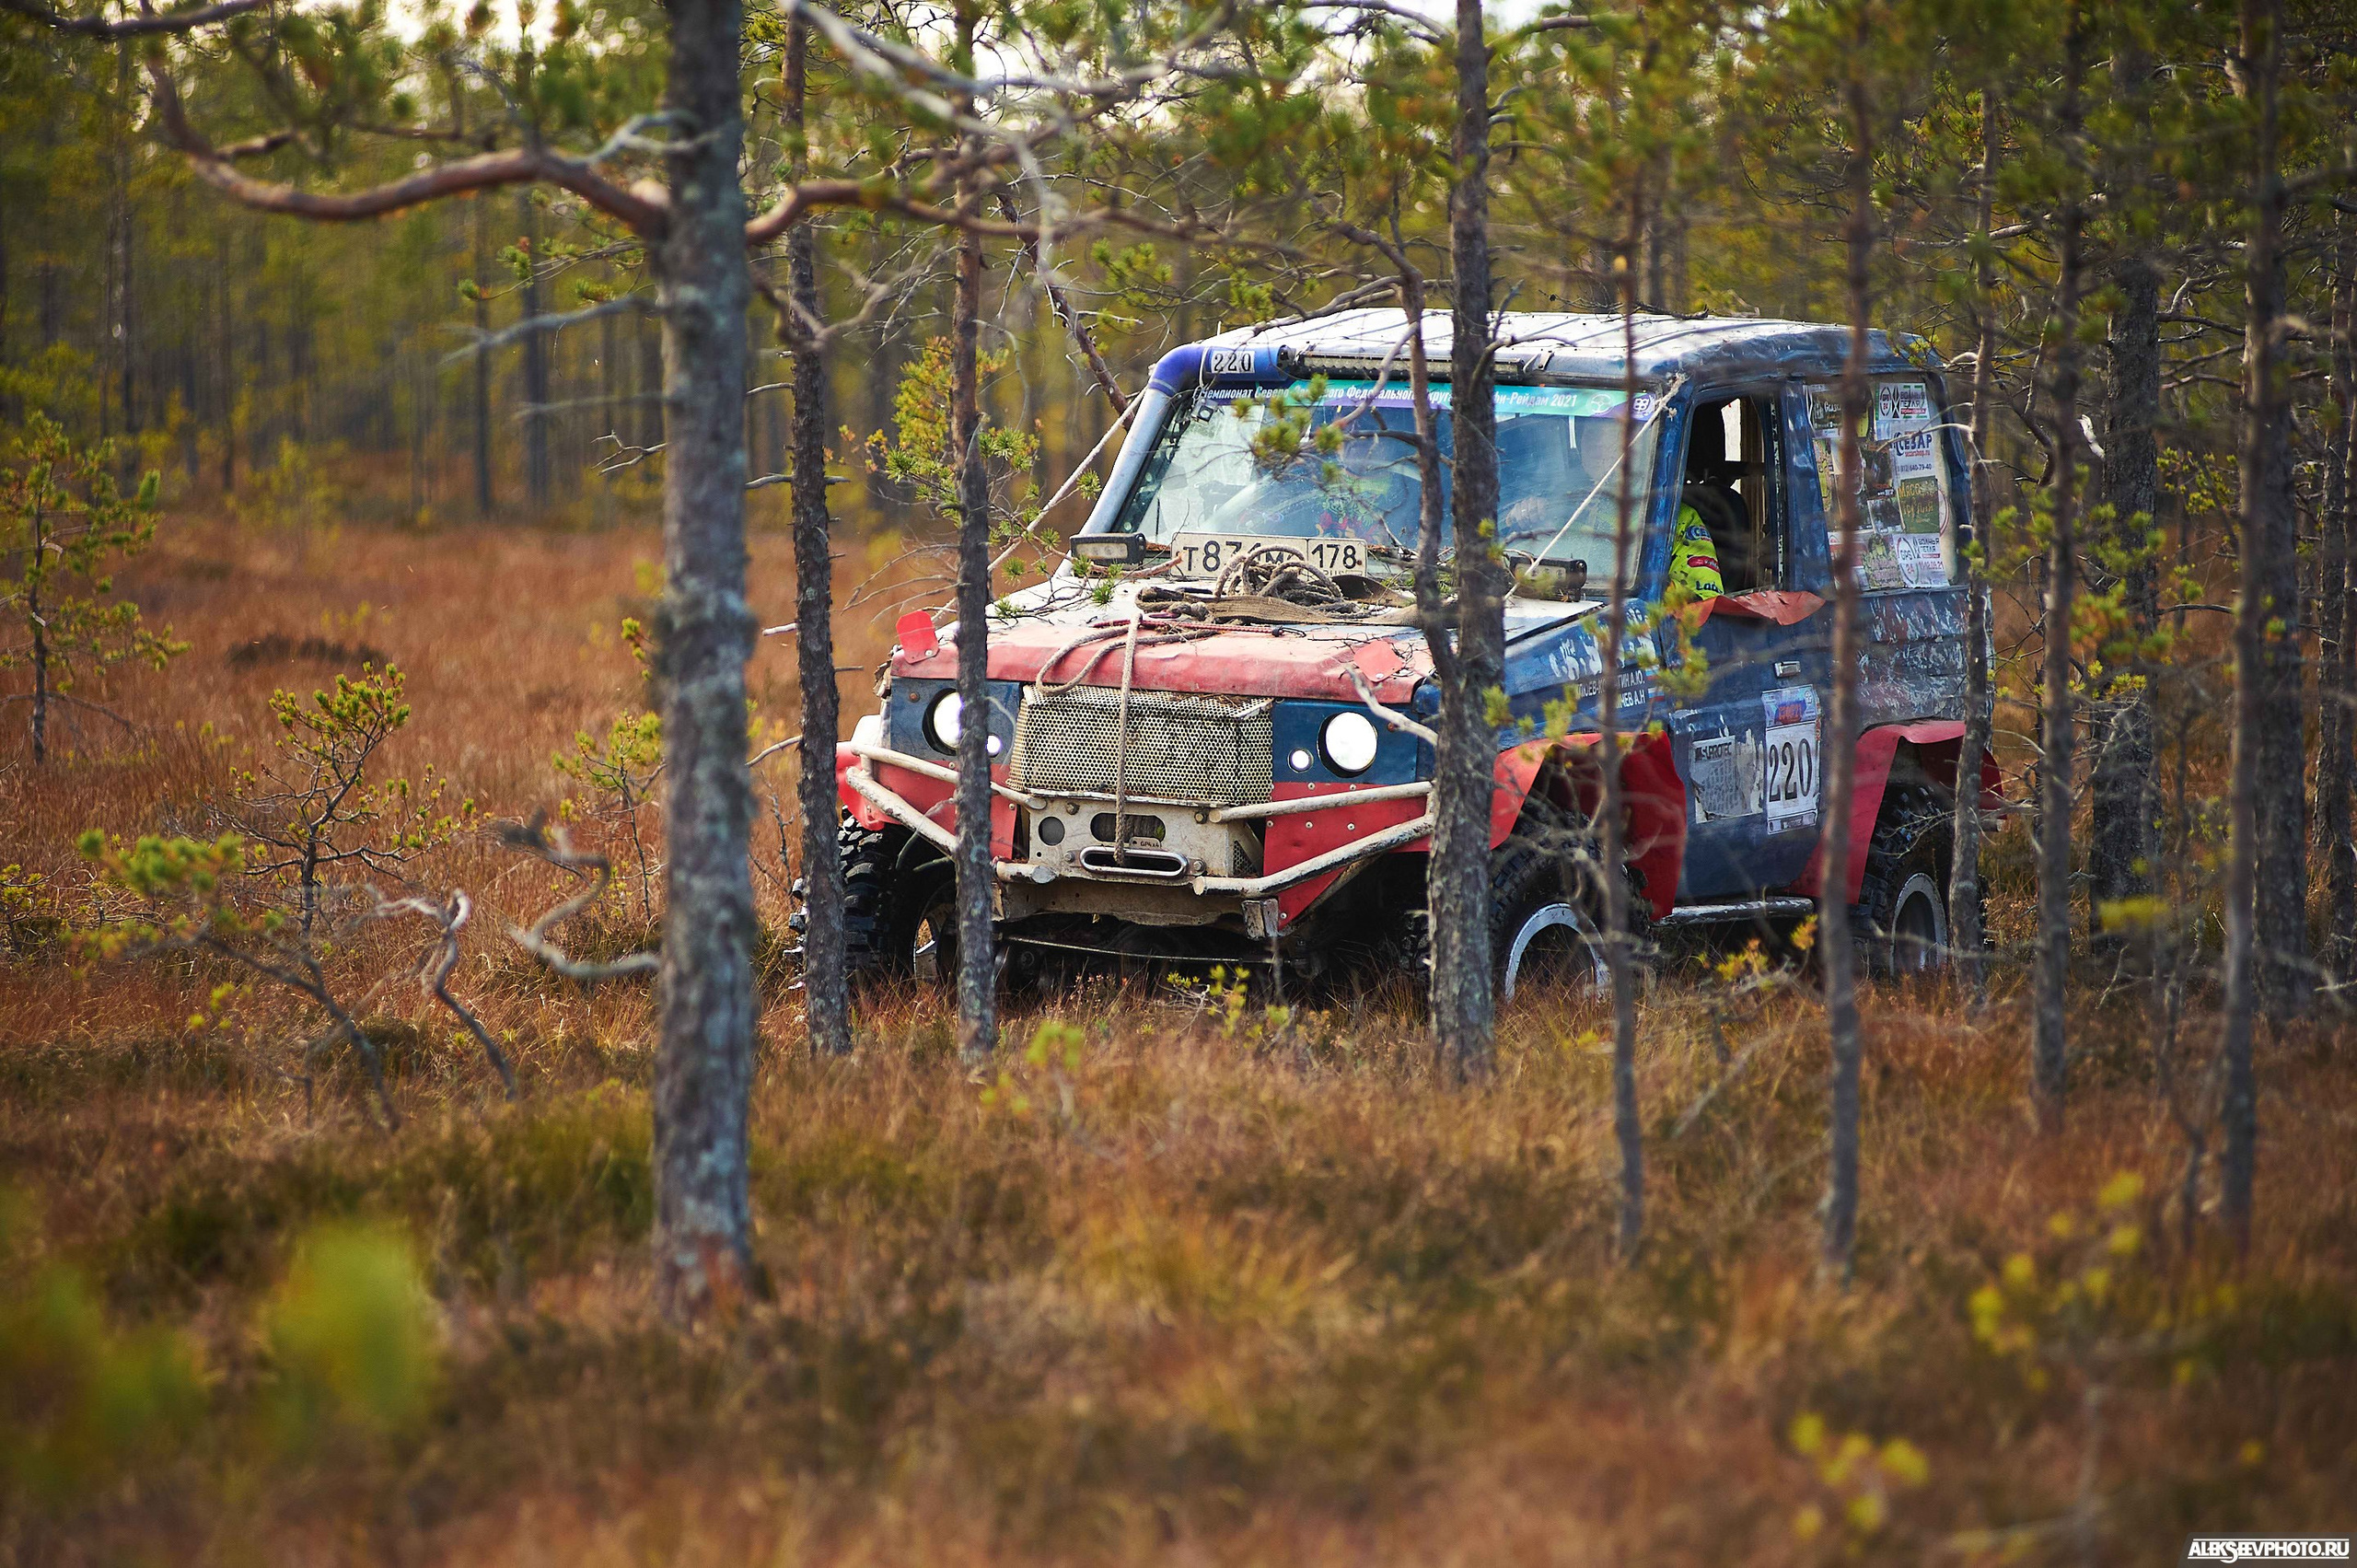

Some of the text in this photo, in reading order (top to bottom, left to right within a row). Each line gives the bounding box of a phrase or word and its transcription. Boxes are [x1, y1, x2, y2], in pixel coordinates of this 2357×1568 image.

[1213, 353, 1252, 372] 220
[1550, 394, 1577, 407] 2021
[1311, 543, 1356, 570] 178
[1769, 738, 1813, 803] 220
